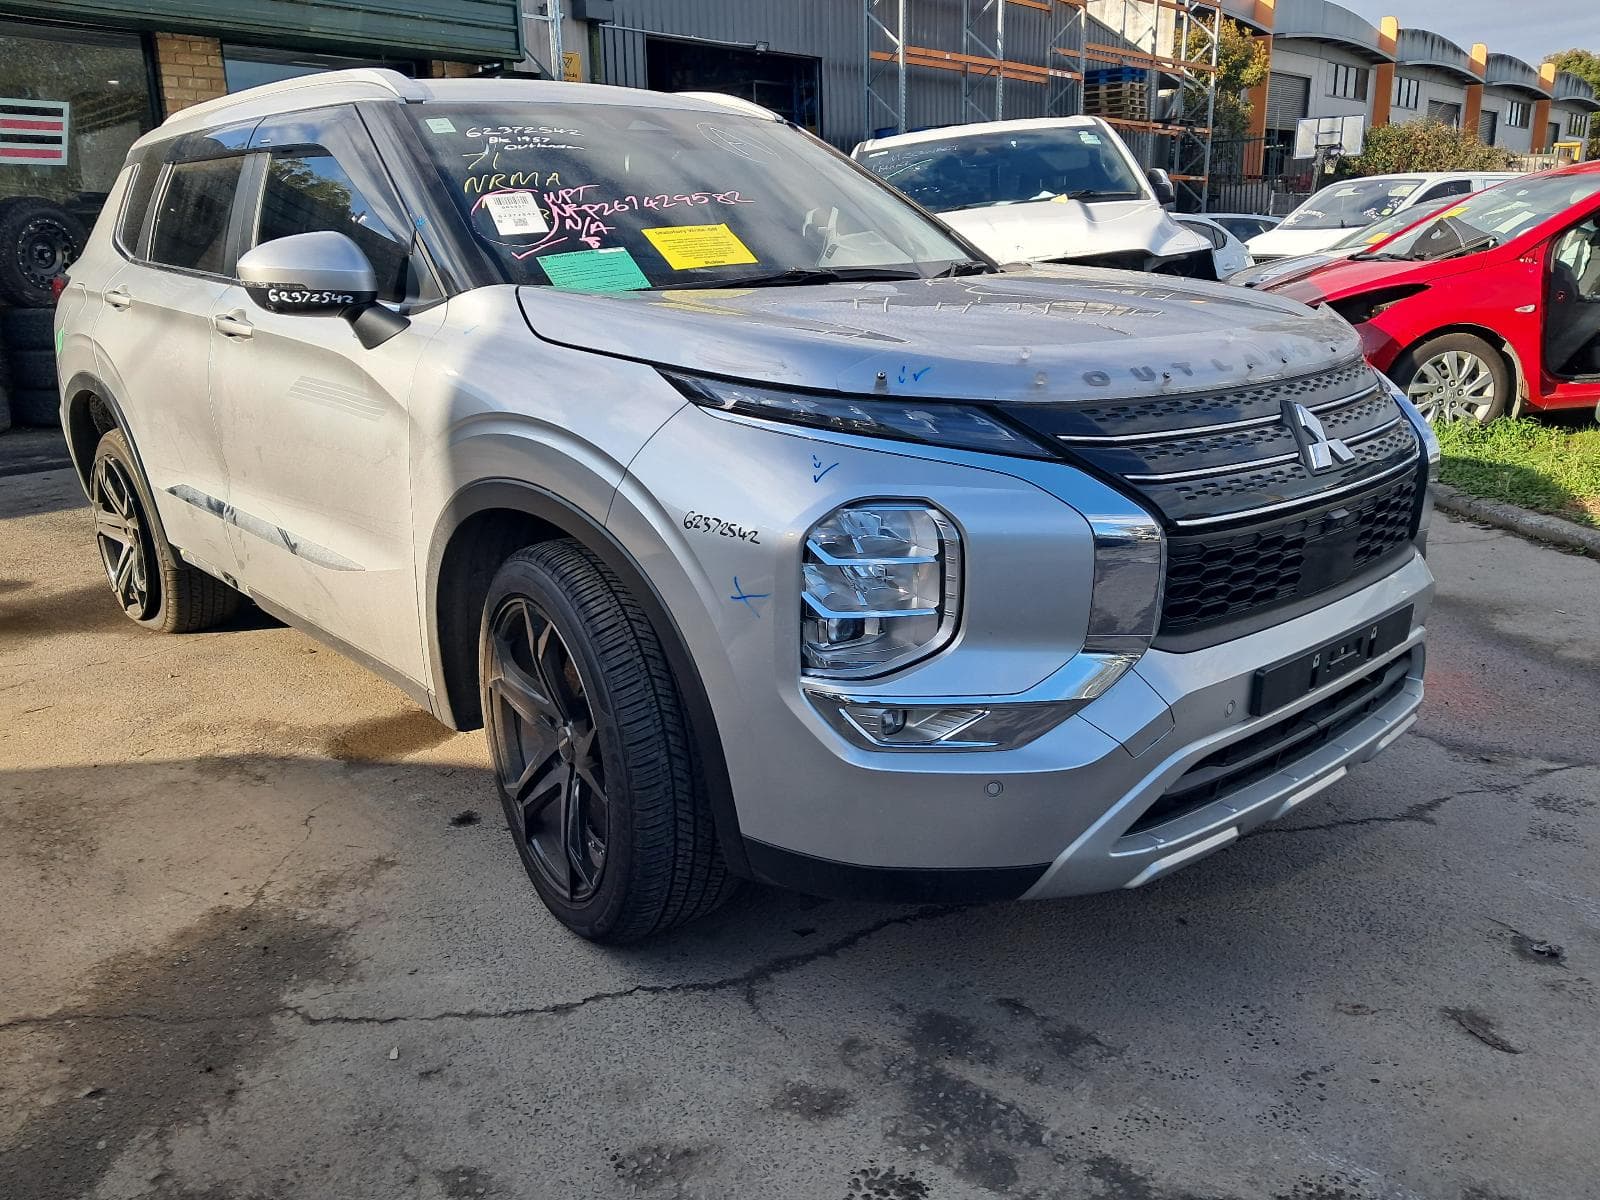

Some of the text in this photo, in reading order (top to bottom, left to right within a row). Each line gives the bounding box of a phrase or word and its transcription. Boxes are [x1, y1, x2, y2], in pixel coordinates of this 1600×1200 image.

[464, 171, 561, 193] NRMA
[267, 288, 354, 304] 62372542
[682, 510, 761, 545] 62372542
